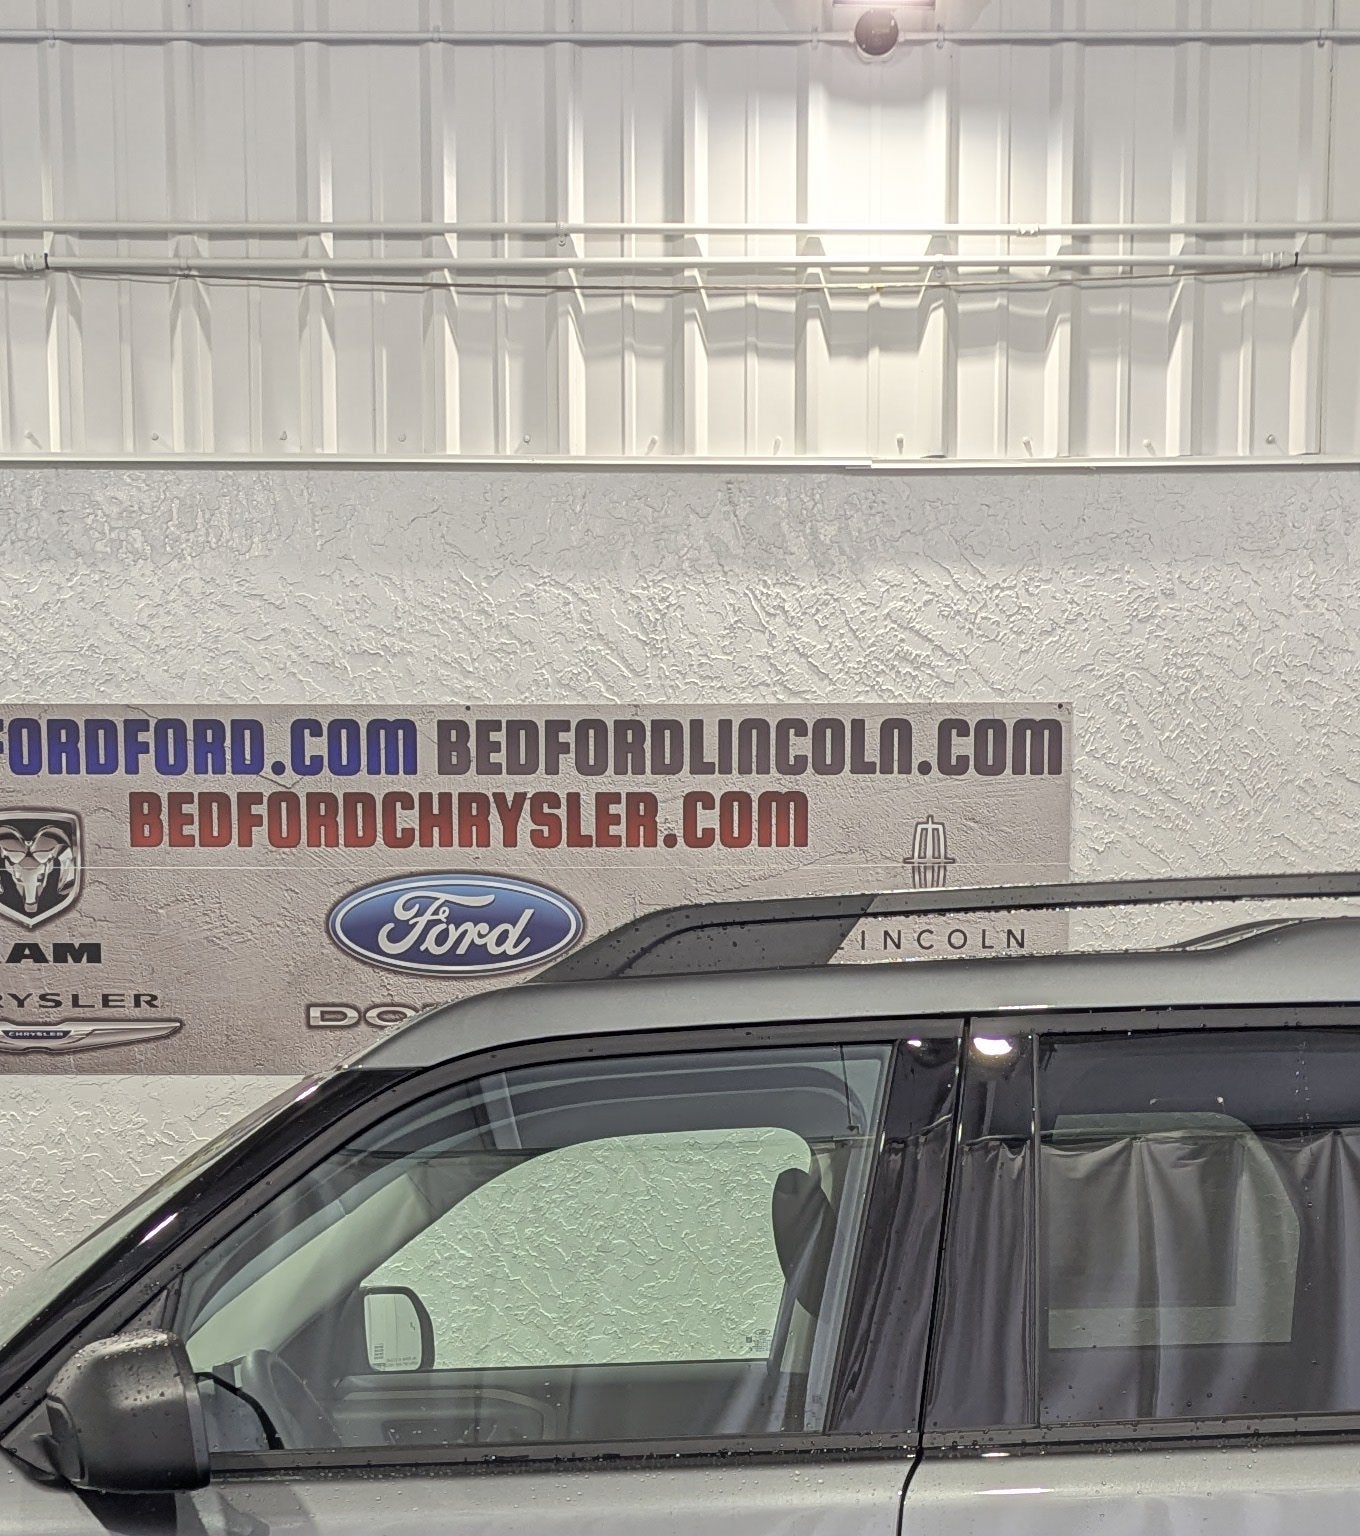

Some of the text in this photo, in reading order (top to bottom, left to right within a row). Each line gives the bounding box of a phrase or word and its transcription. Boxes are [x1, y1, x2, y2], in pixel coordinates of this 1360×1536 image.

[438, 717, 1063, 776] BEDFORDLINCOLN.COM
[129, 790, 808, 849] BEDFORDCHRYSLER.COM
[378, 891, 534, 955] Ford
[837, 928, 1025, 950] INCOLN
